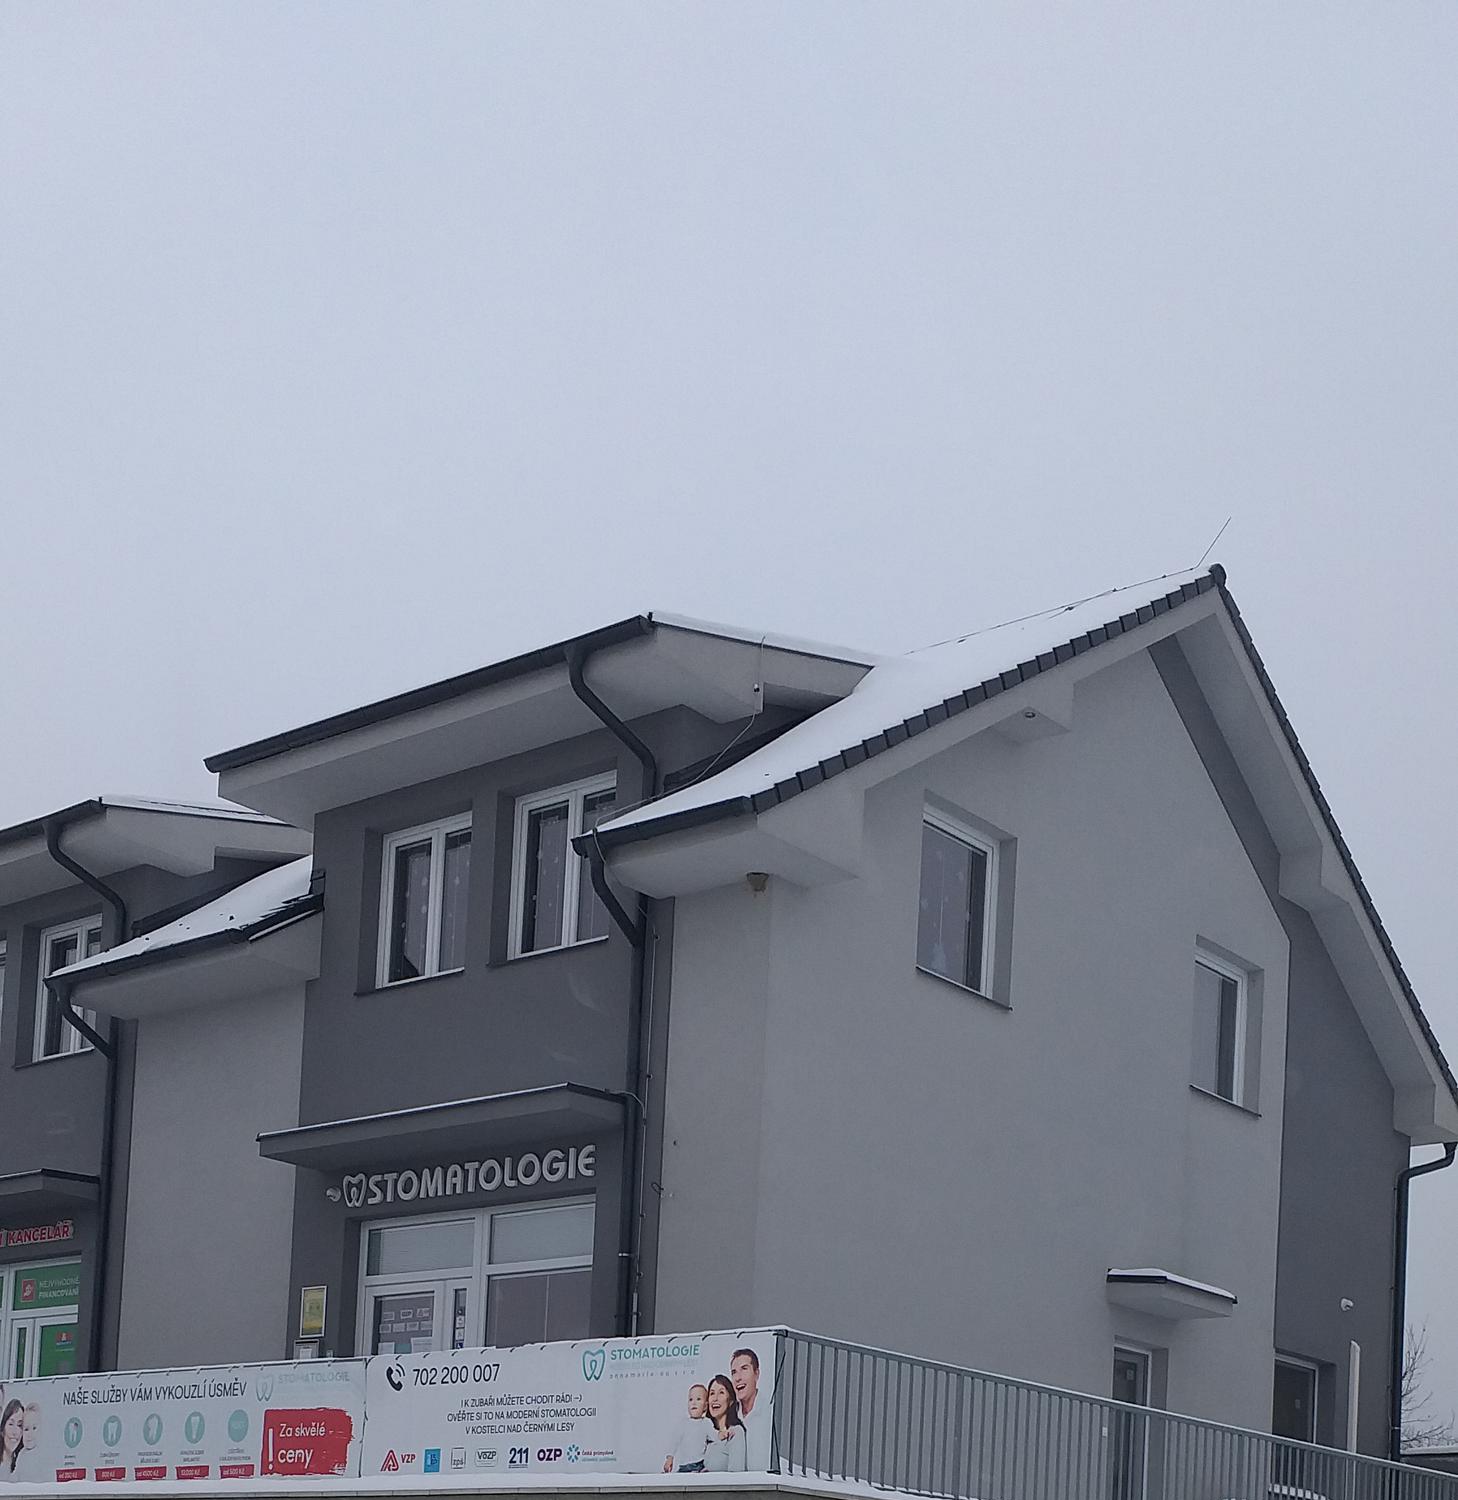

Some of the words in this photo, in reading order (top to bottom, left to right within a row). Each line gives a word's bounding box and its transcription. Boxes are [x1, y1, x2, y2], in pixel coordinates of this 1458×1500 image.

[367, 1144, 597, 1205] STOMATOLOGIE
[610, 1344, 700, 1360] STOMATOLOGIE
[412, 1367, 437, 1387] 702
[440, 1365, 470, 1386] 200
[472, 1363, 500, 1384] 007
[63, 1386, 89, 1405] NAŠE
[91, 1384, 128, 1404] SLUŽBY
[130, 1382, 152, 1402] VÁM
[155, 1379, 206, 1401] VYKOUZLÍ
[208, 1377, 247, 1398] ÚSMĚV
[470, 1395, 496, 1408] ZUBAŘI
[496, 1393, 525, 1406] MŮŽETE
[525, 1394, 555, 1405] CHODIT
[475, 1412, 482, 1421] SI
[484, 1411, 494, 1421] TO
[494, 1411, 505, 1420] NA
[506, 1406, 540, 1419] MODERNÍ
[540, 1407, 597, 1418] STOMATOLOGII
[279, 1423, 293, 1437] Za
[294, 1421, 326, 1437] skvělé
[471, 1424, 506, 1435] KOSTELCI
[506, 1423, 522, 1433] NAD
[556, 1422, 575, 1432] LESY
[278, 1448, 313, 1469] ceny
[400, 1453, 416, 1464] VZP
[508, 1447, 529, 1464] 211
[537, 1448, 562, 1462] OZP
